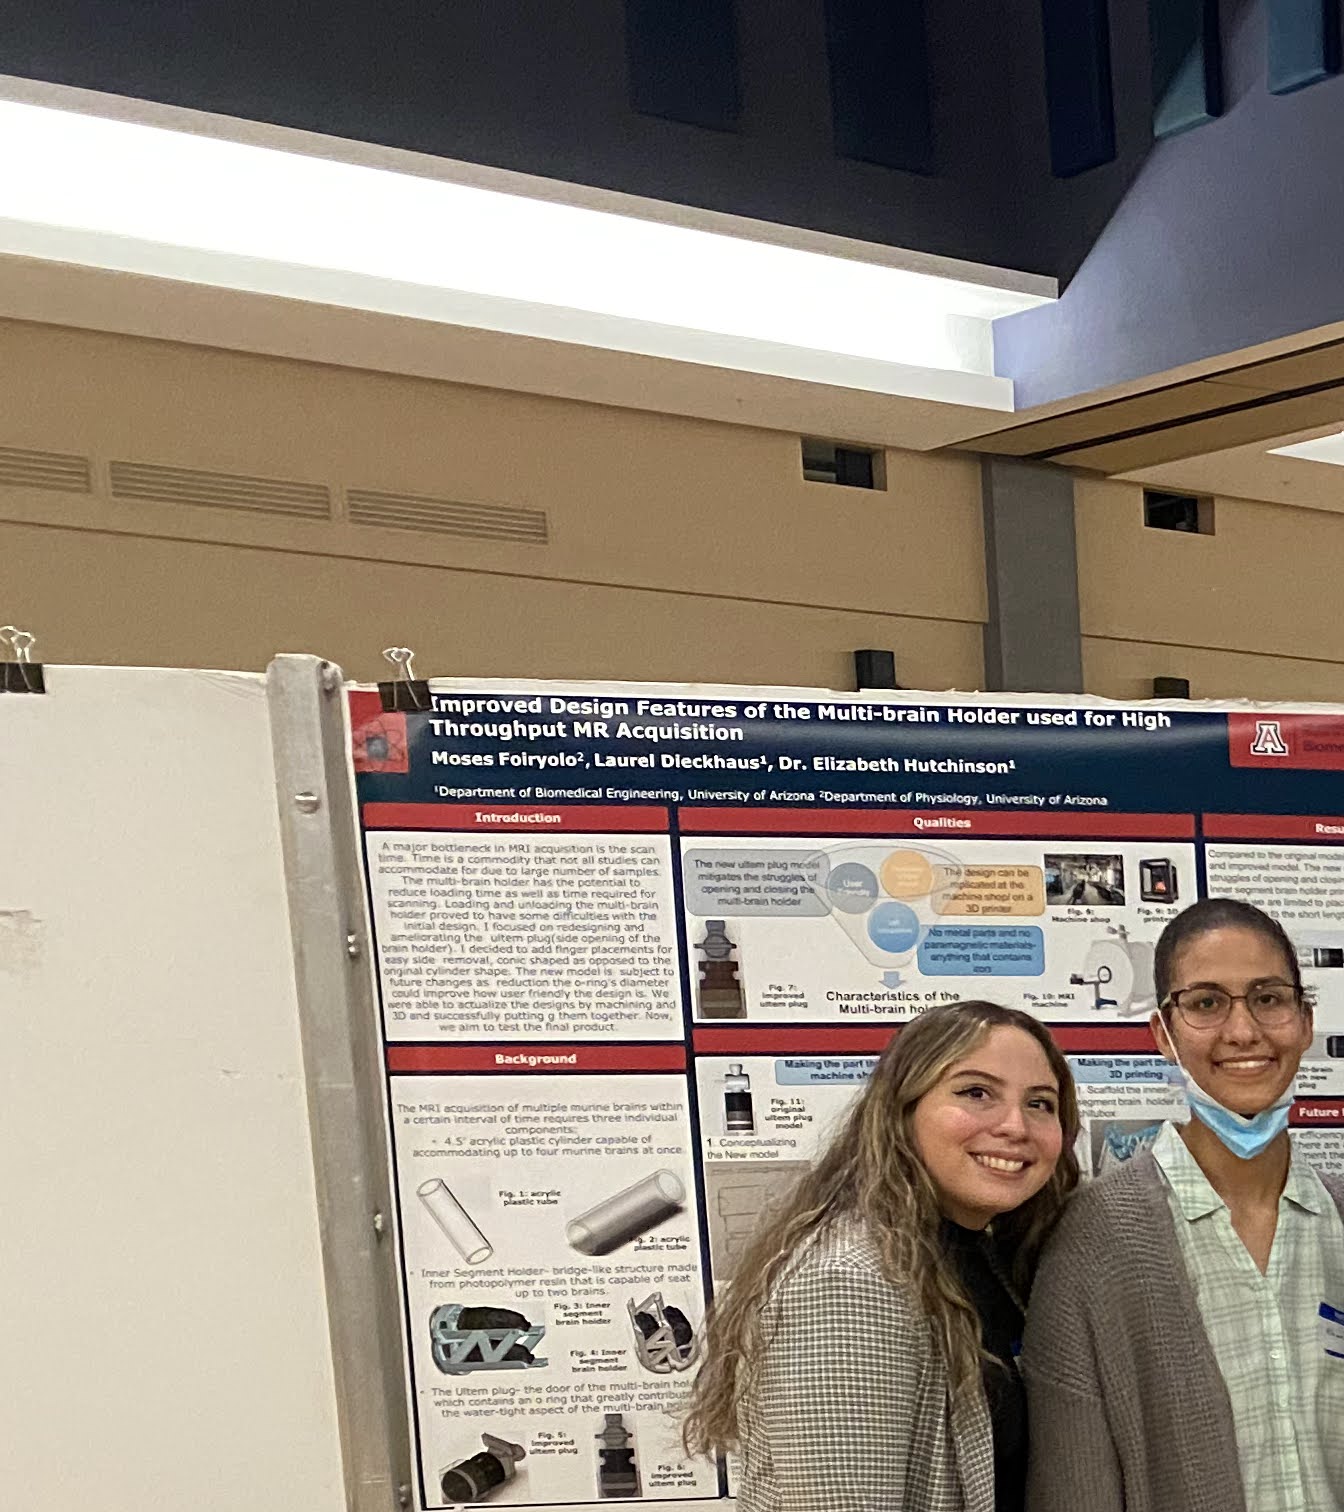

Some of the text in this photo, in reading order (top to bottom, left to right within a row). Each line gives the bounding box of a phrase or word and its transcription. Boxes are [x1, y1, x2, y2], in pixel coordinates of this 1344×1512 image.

[429, 695, 1171, 731] Improved Design Features of the Multi-brain Holder used for High
[428, 719, 743, 743] Throughput MR Acquisition
[432, 751, 494, 766] Moses
[594, 753, 655, 768] Laurel
[779, 756, 807, 770] Dr.
[813, 756, 899, 772] Elizabeth
[519, 787, 532, 798] of
[535, 787, 602, 798] Biomedical
[606, 788, 683, 802] Engineering,
[688, 789, 750, 802] University
[753, 789, 766, 800] of
[769, 790, 815, 801] Arizona
[900, 792, 912, 803] of
[915, 792, 982, 806] Physiology,
[986, 794, 1045, 806] University
[1049, 795, 1061, 805] of
[1064, 795, 1108, 806] Arizona
[475, 812, 561, 823] Introduction
[914, 817, 971, 830] Qualities
[826, 991, 960, 1001] Characteristics of the
[495, 1054, 577, 1066] Background
[1299, 1107, 1339, 1117] Future
